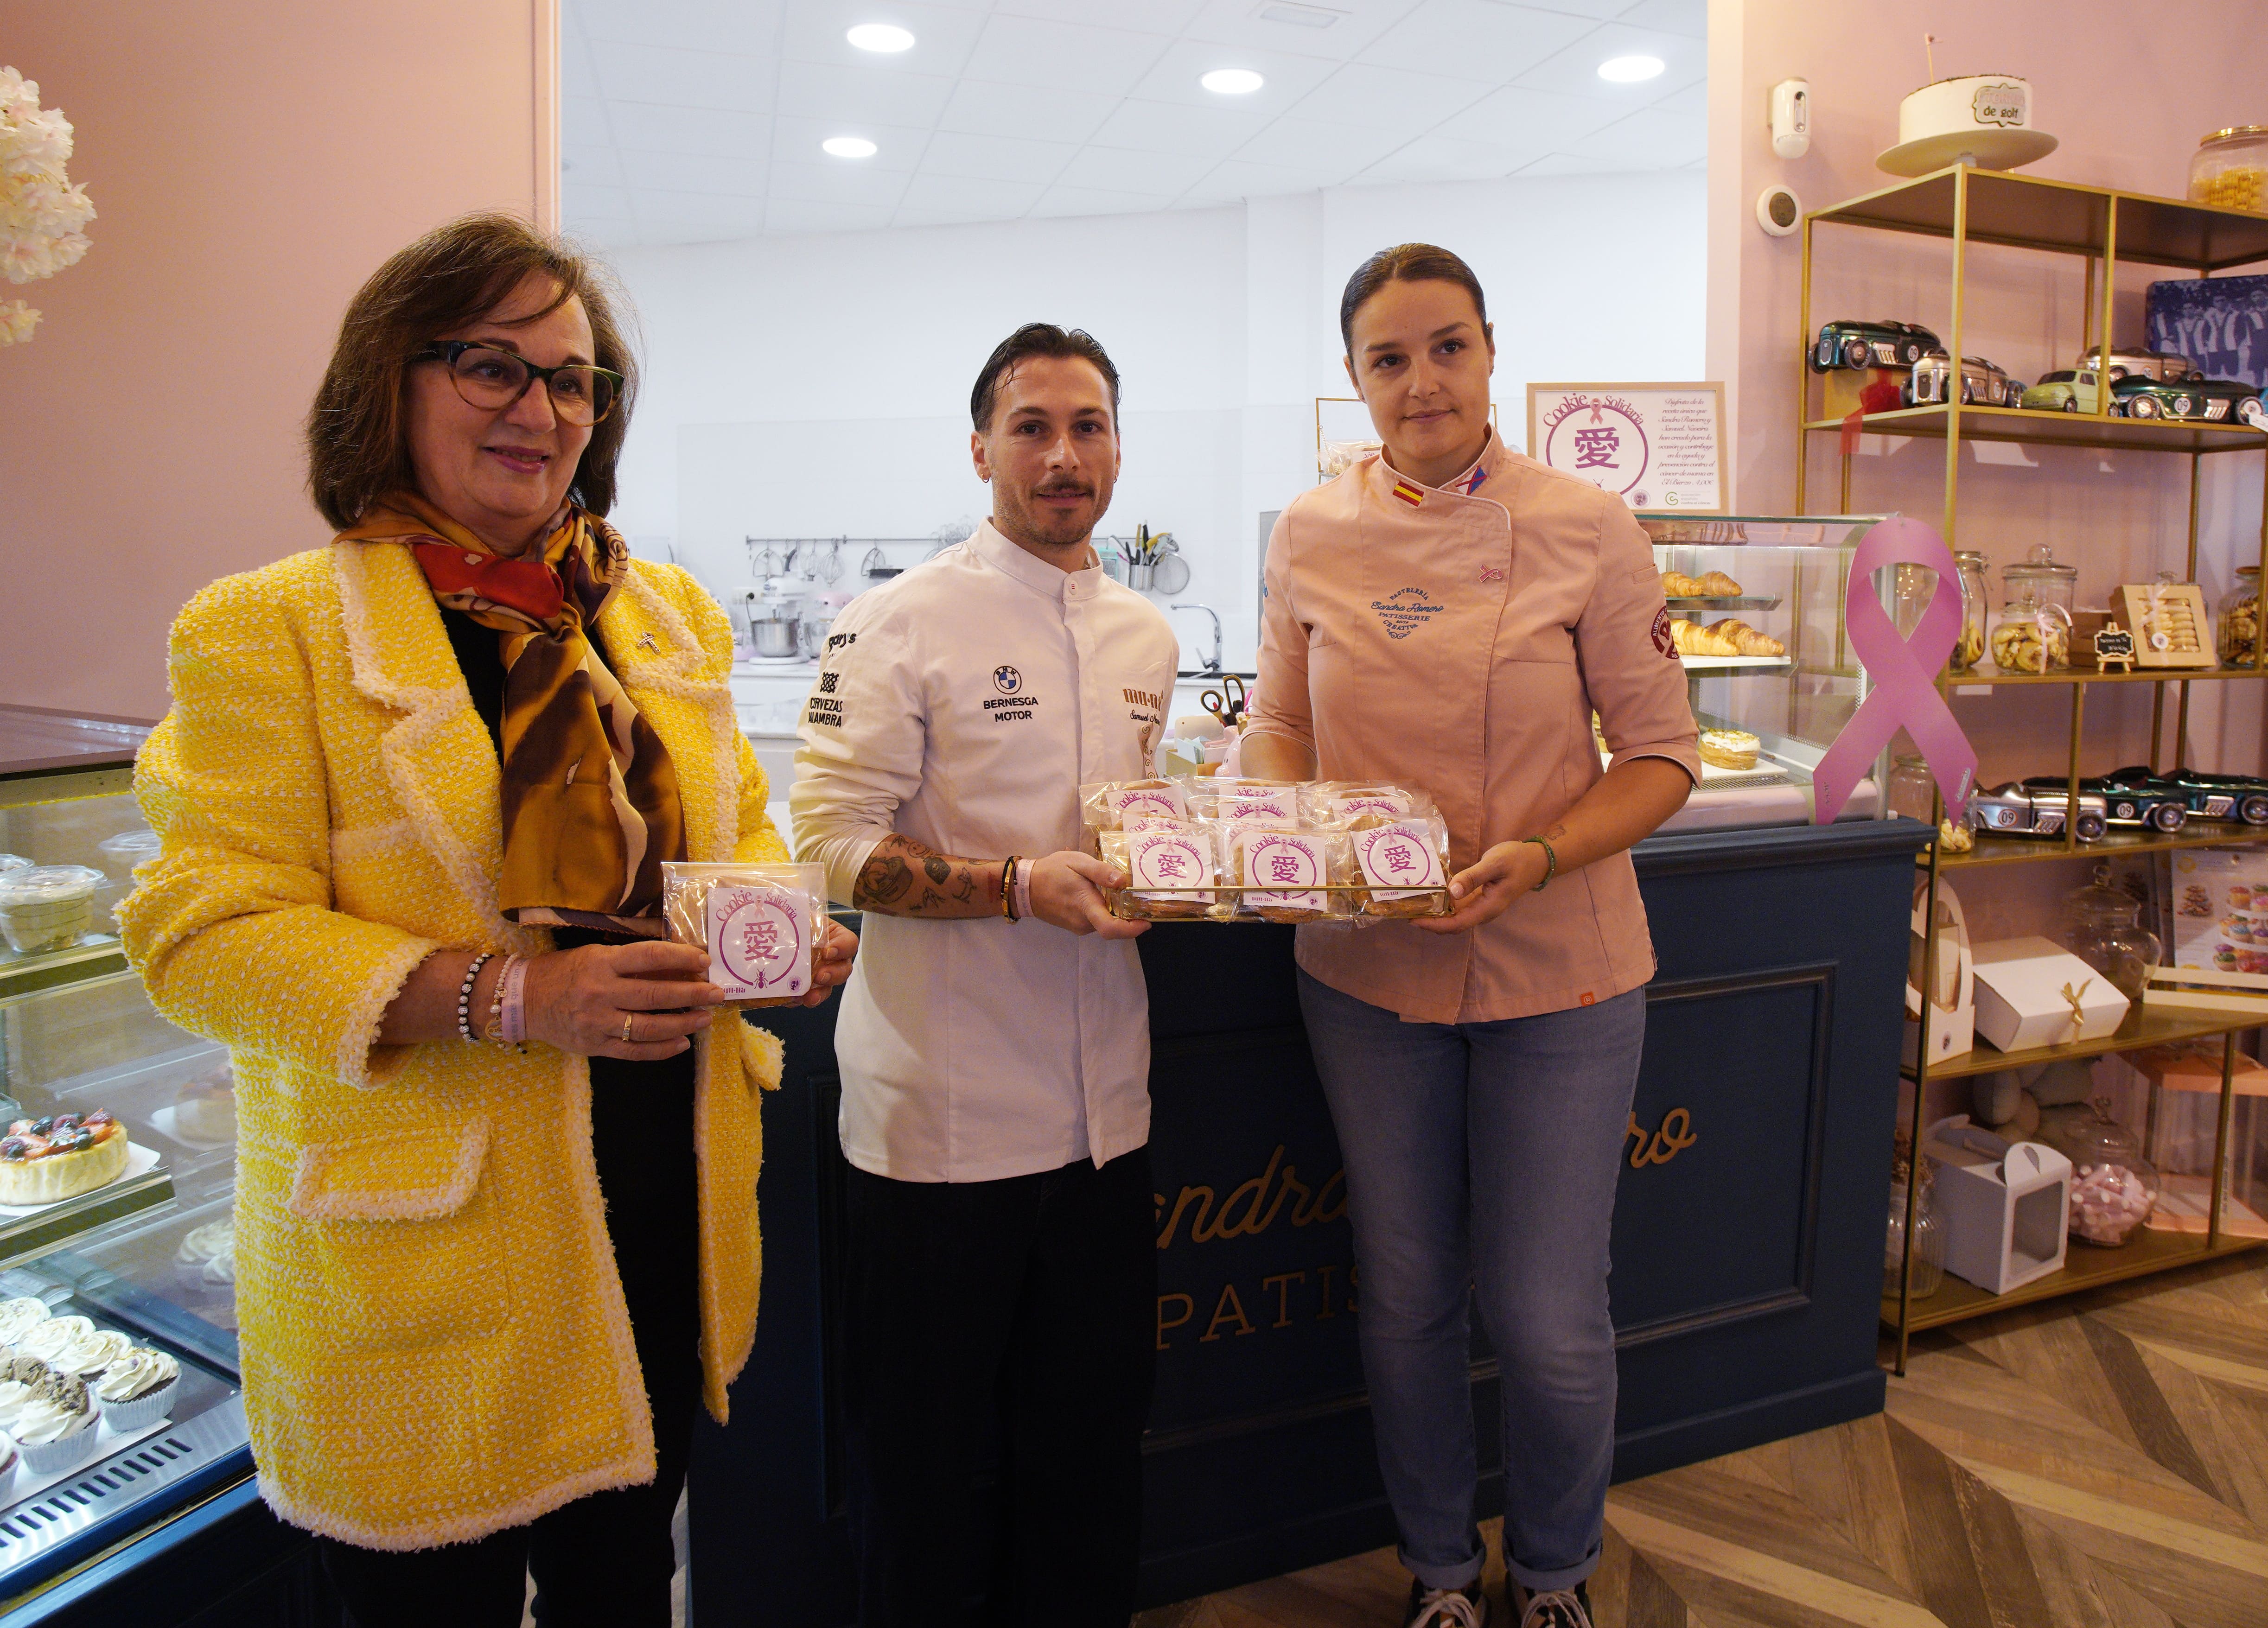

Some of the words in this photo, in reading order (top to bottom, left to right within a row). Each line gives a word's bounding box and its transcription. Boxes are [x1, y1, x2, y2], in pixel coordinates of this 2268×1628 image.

[1984, 106, 1996, 116] de
[1543, 393, 1588, 427] Cookie
[1605, 395, 1644, 425] Solidaria
[1575, 427, 1620, 469] 愛
[1389, 587, 1429, 601] PASTELERÍA
[1371, 601, 1405, 611] Sandra
[1407, 603, 1445, 613] Romero
[1378, 612, 1431, 622] PATISSERIE
[1383, 620, 1419, 630] CREATIVA
[983, 697, 1039, 709] BERNESGA
[994, 710, 1033, 722] MOTOR
[1130, 709, 1149, 722] Samuel
[1114, 791, 1141, 809] Cookie
[1148, 792, 1175, 808] Solidaria
[2002, 813, 2014, 824] 09
[1135, 835, 1166, 854] Cookie
[1174, 838, 1201, 857] Solidaria
[1249, 834, 1281, 853] Cookie
[1288, 837, 1315, 858] Solidaria
[1360, 828, 1387, 852] Cookie
[1394, 826, 1421, 842] Solidaria
[1158, 854, 1187, 879] 愛
[1384, 845, 1416, 873] 愛
[1271, 856, 1300, 884] 愛
[715, 890, 753, 922] Cookie
[765, 892, 797, 921] Solidaria
[743, 920, 779, 961] 愛
